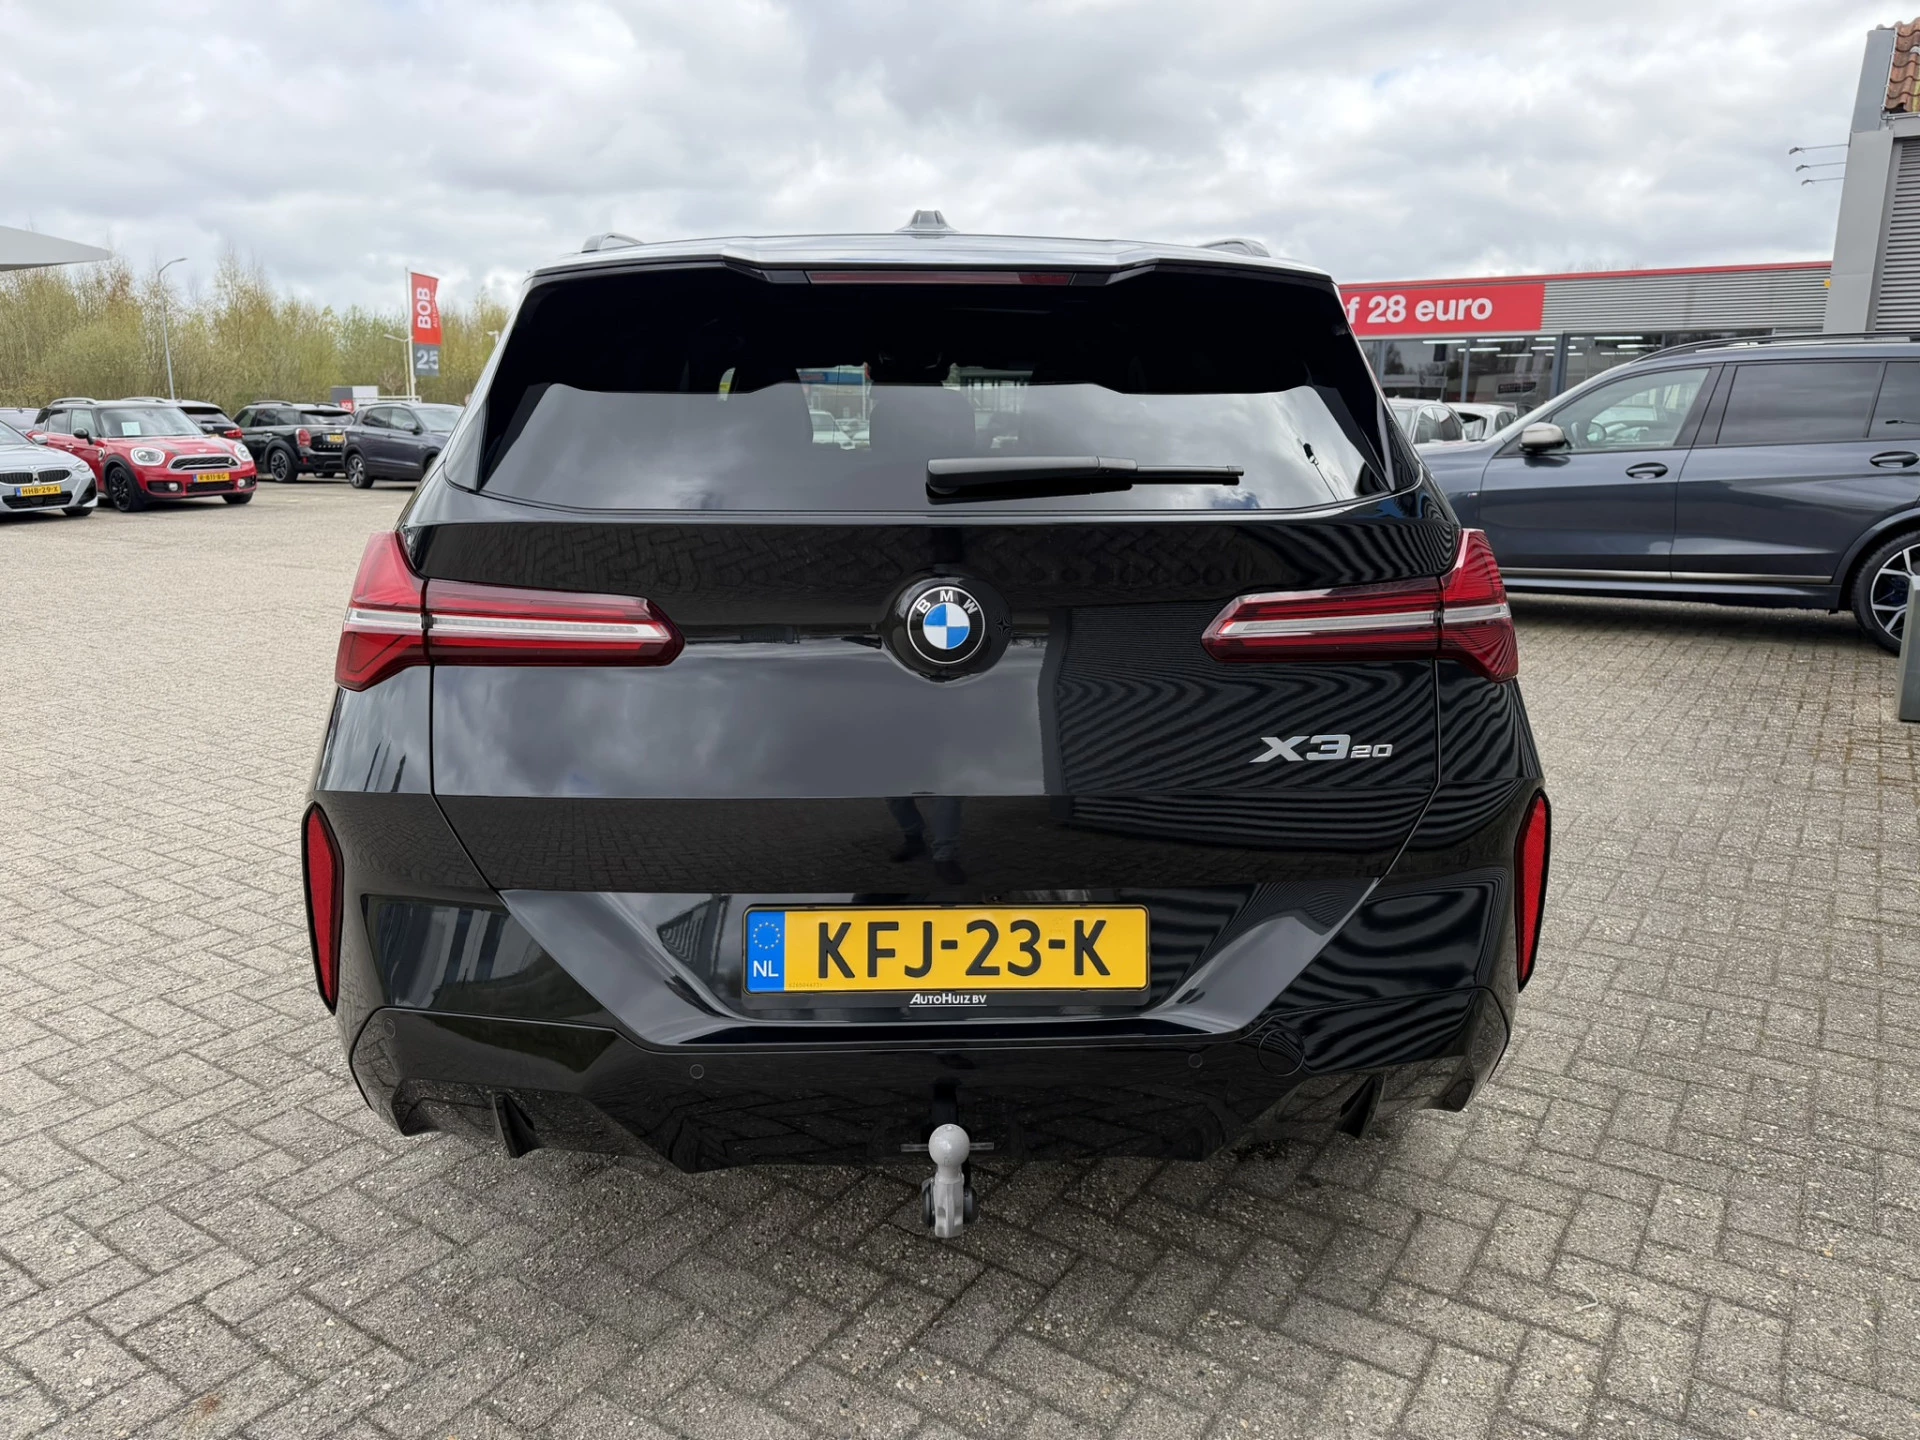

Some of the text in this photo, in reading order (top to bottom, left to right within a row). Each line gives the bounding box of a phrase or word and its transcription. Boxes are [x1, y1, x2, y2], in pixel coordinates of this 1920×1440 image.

[417, 287, 432, 329] BOB
[1346, 294, 1493, 325] f 28 euro
[416, 349, 439, 370] 25
[916, 590, 978, 615] BMW
[818, 919, 1111, 979] KFJ-23-K
[753, 960, 779, 978] NL
[972, 994, 987, 1004] BV
